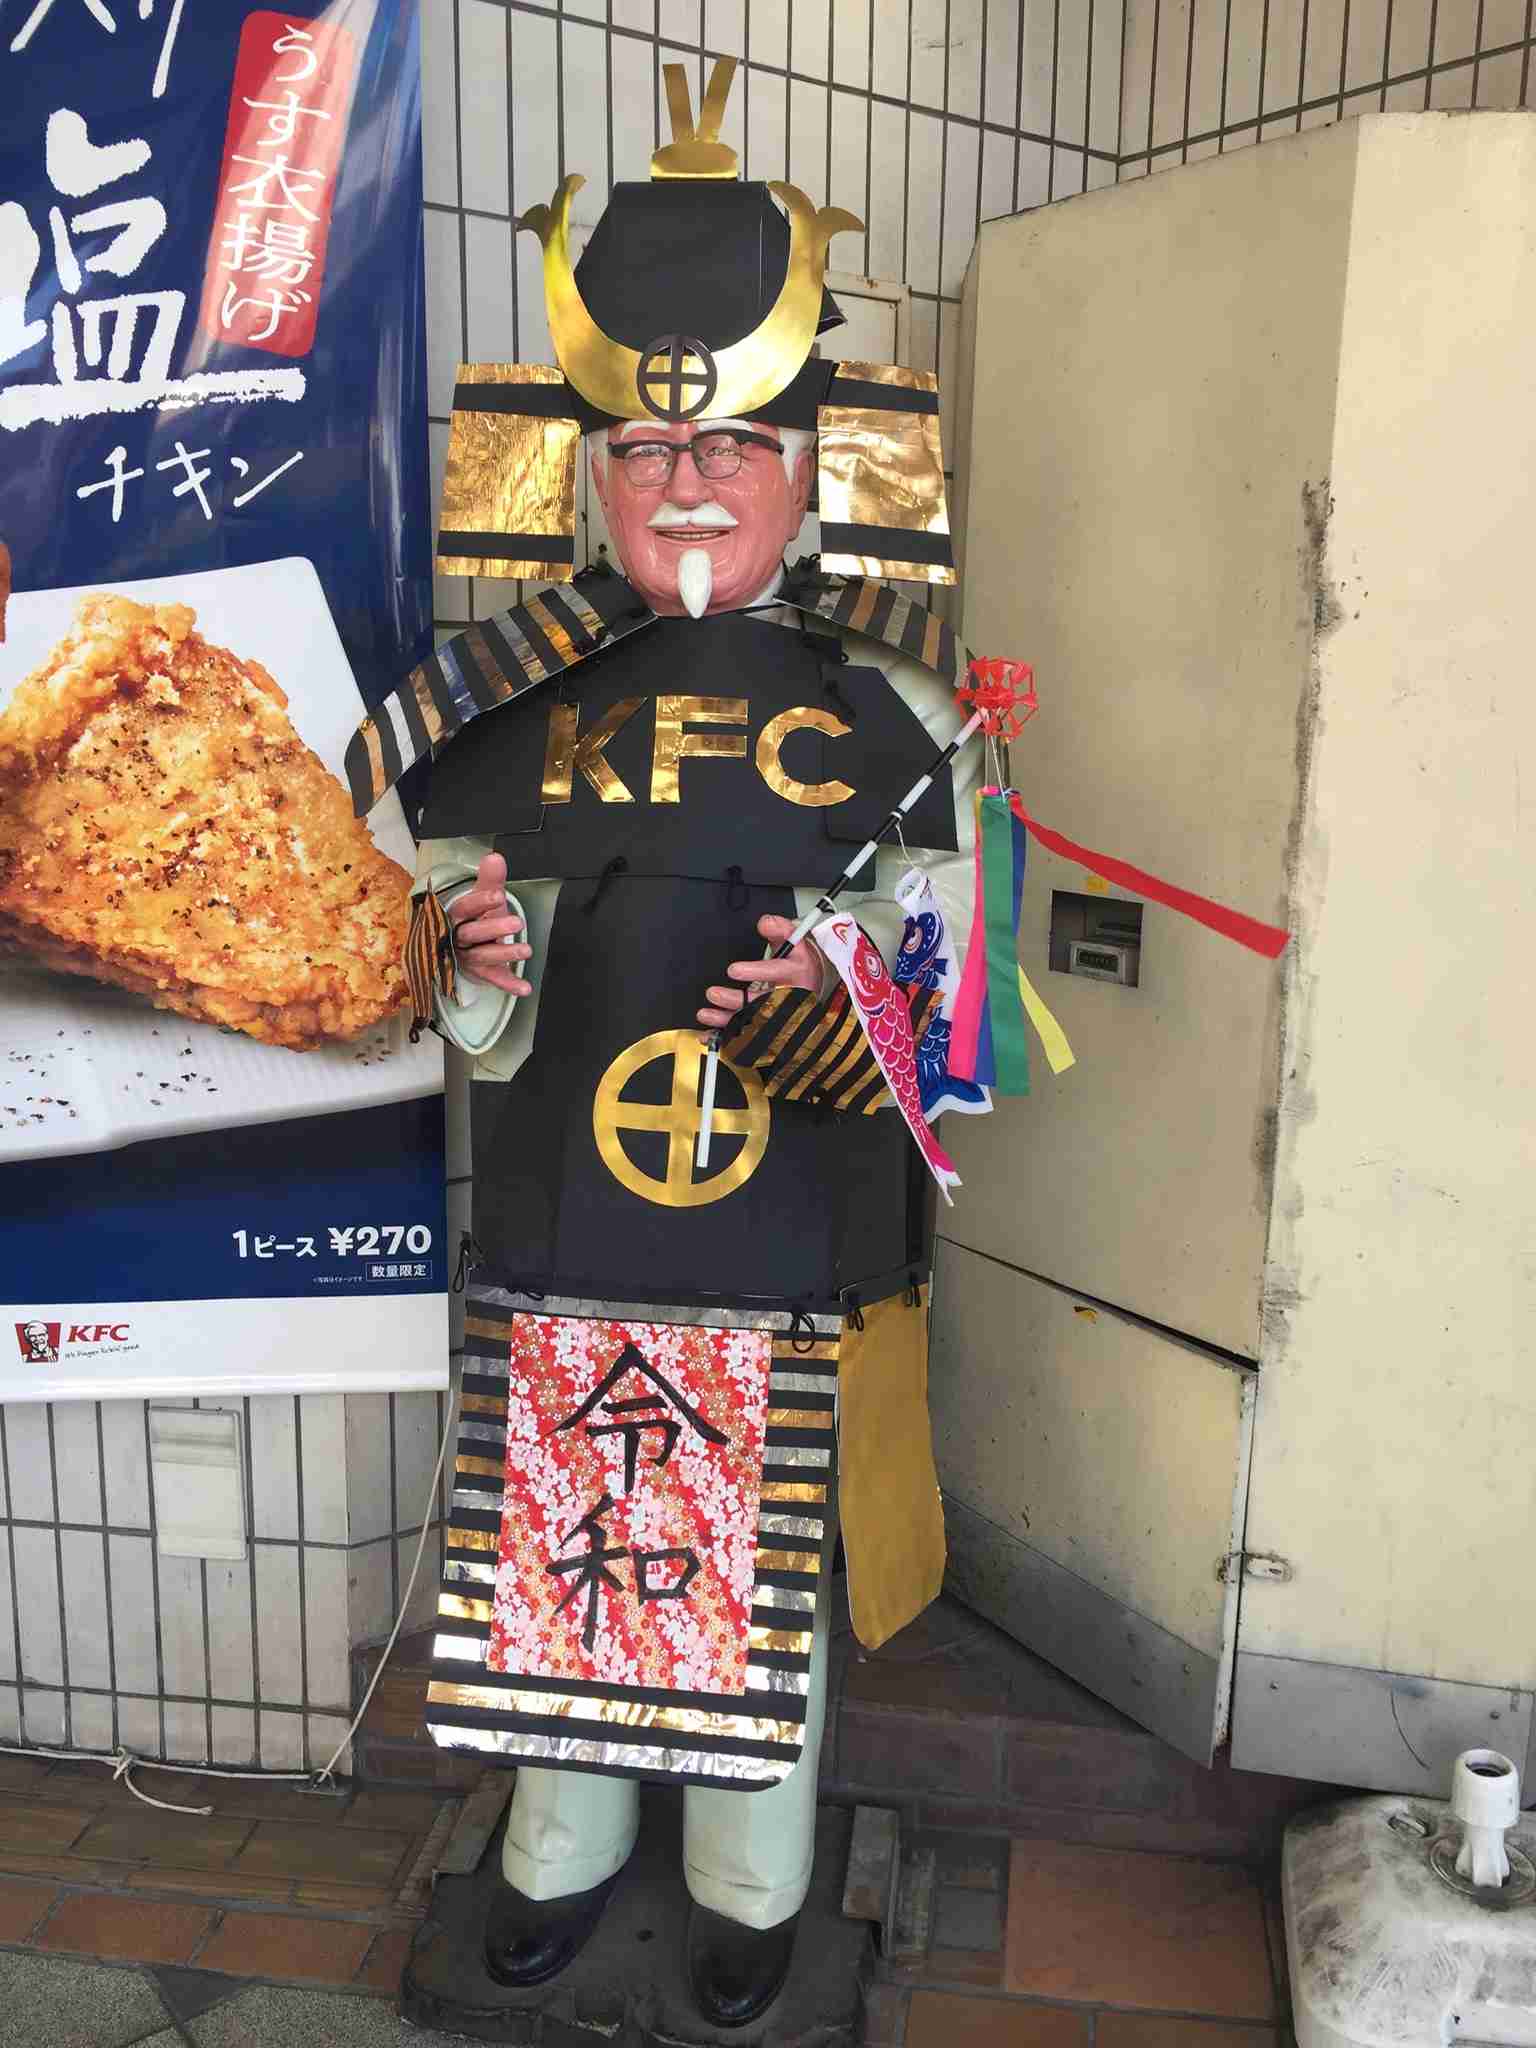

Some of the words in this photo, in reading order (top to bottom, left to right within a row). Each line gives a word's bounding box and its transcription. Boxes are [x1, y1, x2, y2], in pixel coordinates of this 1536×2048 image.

[221, 24, 332, 341] うす衣揚げ
[77, 442, 303, 523] チキン
[541, 695, 857, 807] KFC
[327, 1225, 432, 1257] ¥270
[371, 1263, 428, 1279] 数量限定
[68, 1323, 130, 1343] KFC
[543, 1342, 731, 1654] 令和
